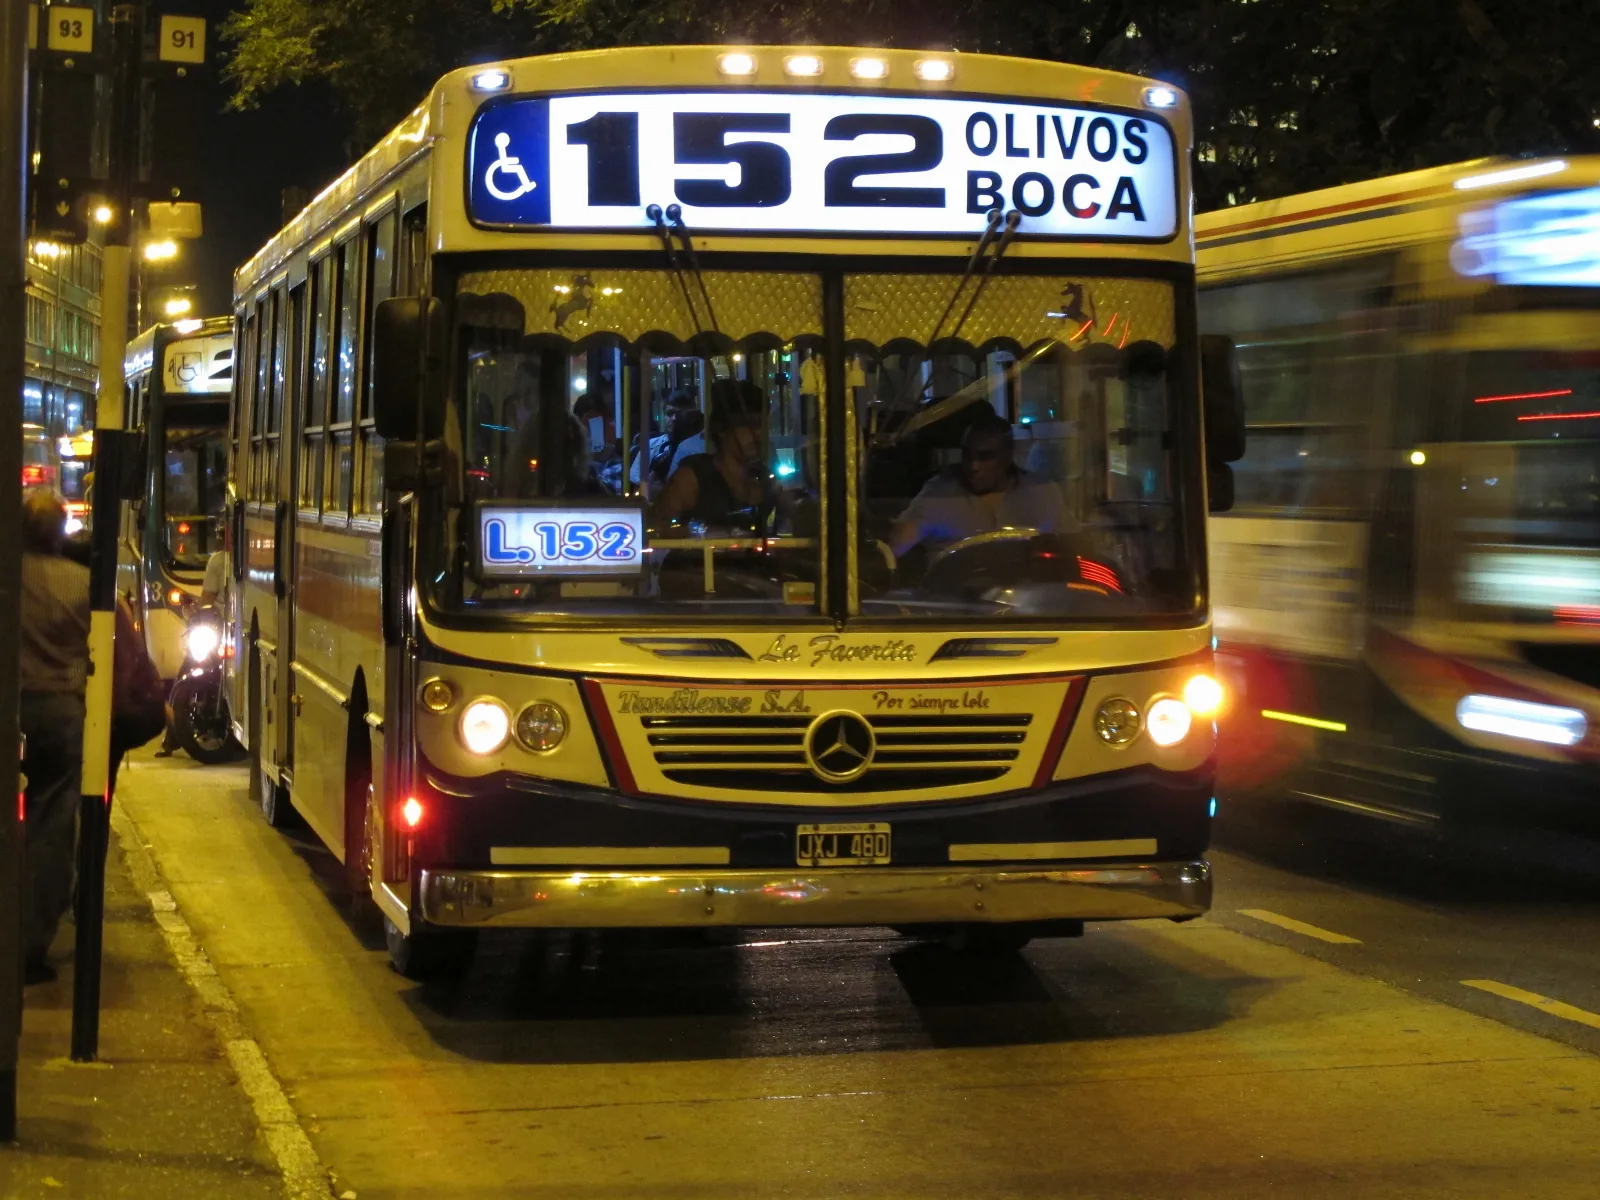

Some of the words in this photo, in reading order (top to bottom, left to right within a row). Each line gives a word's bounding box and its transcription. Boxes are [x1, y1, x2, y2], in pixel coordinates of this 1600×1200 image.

[59, 19, 83, 38] 93
[171, 29, 195, 49] 91
[965, 111, 1149, 164] OLIVOS
[566, 111, 946, 208] 152
[966, 170, 1147, 222] BOCA
[758, 634, 800, 663] La
[809, 635, 917, 667] Favorita
[618, 688, 752, 713] Tandilense
[760, 689, 811, 713] S.A.
[872, 691, 904, 709] Por
[909, 693, 960, 714] siempre
[800, 834, 838, 858] JXJ
[850, 833, 887, 857] 480
